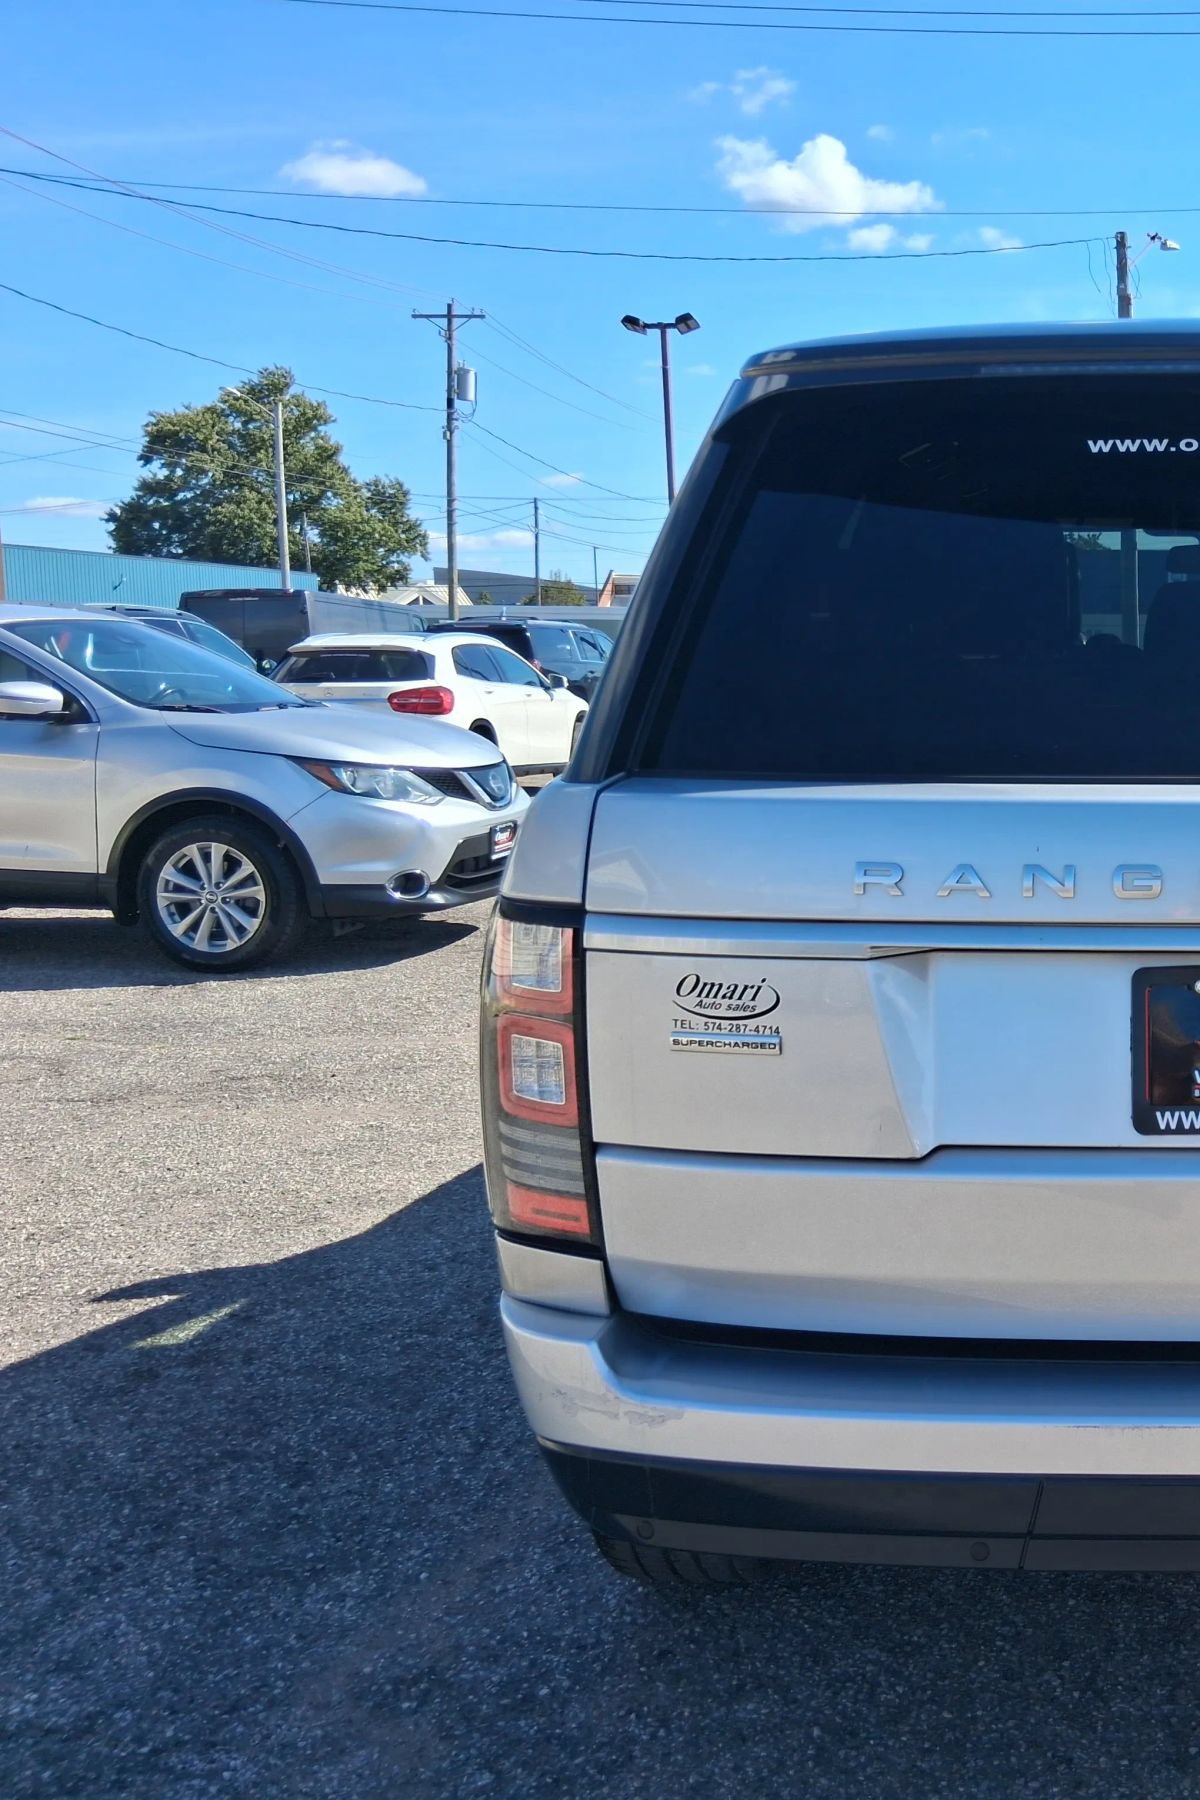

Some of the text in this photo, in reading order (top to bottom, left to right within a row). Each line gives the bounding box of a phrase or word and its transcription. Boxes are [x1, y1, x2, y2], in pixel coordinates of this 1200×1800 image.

[676, 973, 767, 1002] Omari
[693, 1000, 757, 1013] Auto sales
[672, 1019, 781, 1035] TEL: 574-287-4714
[672, 1038, 777, 1050] SUPERCHARGED
